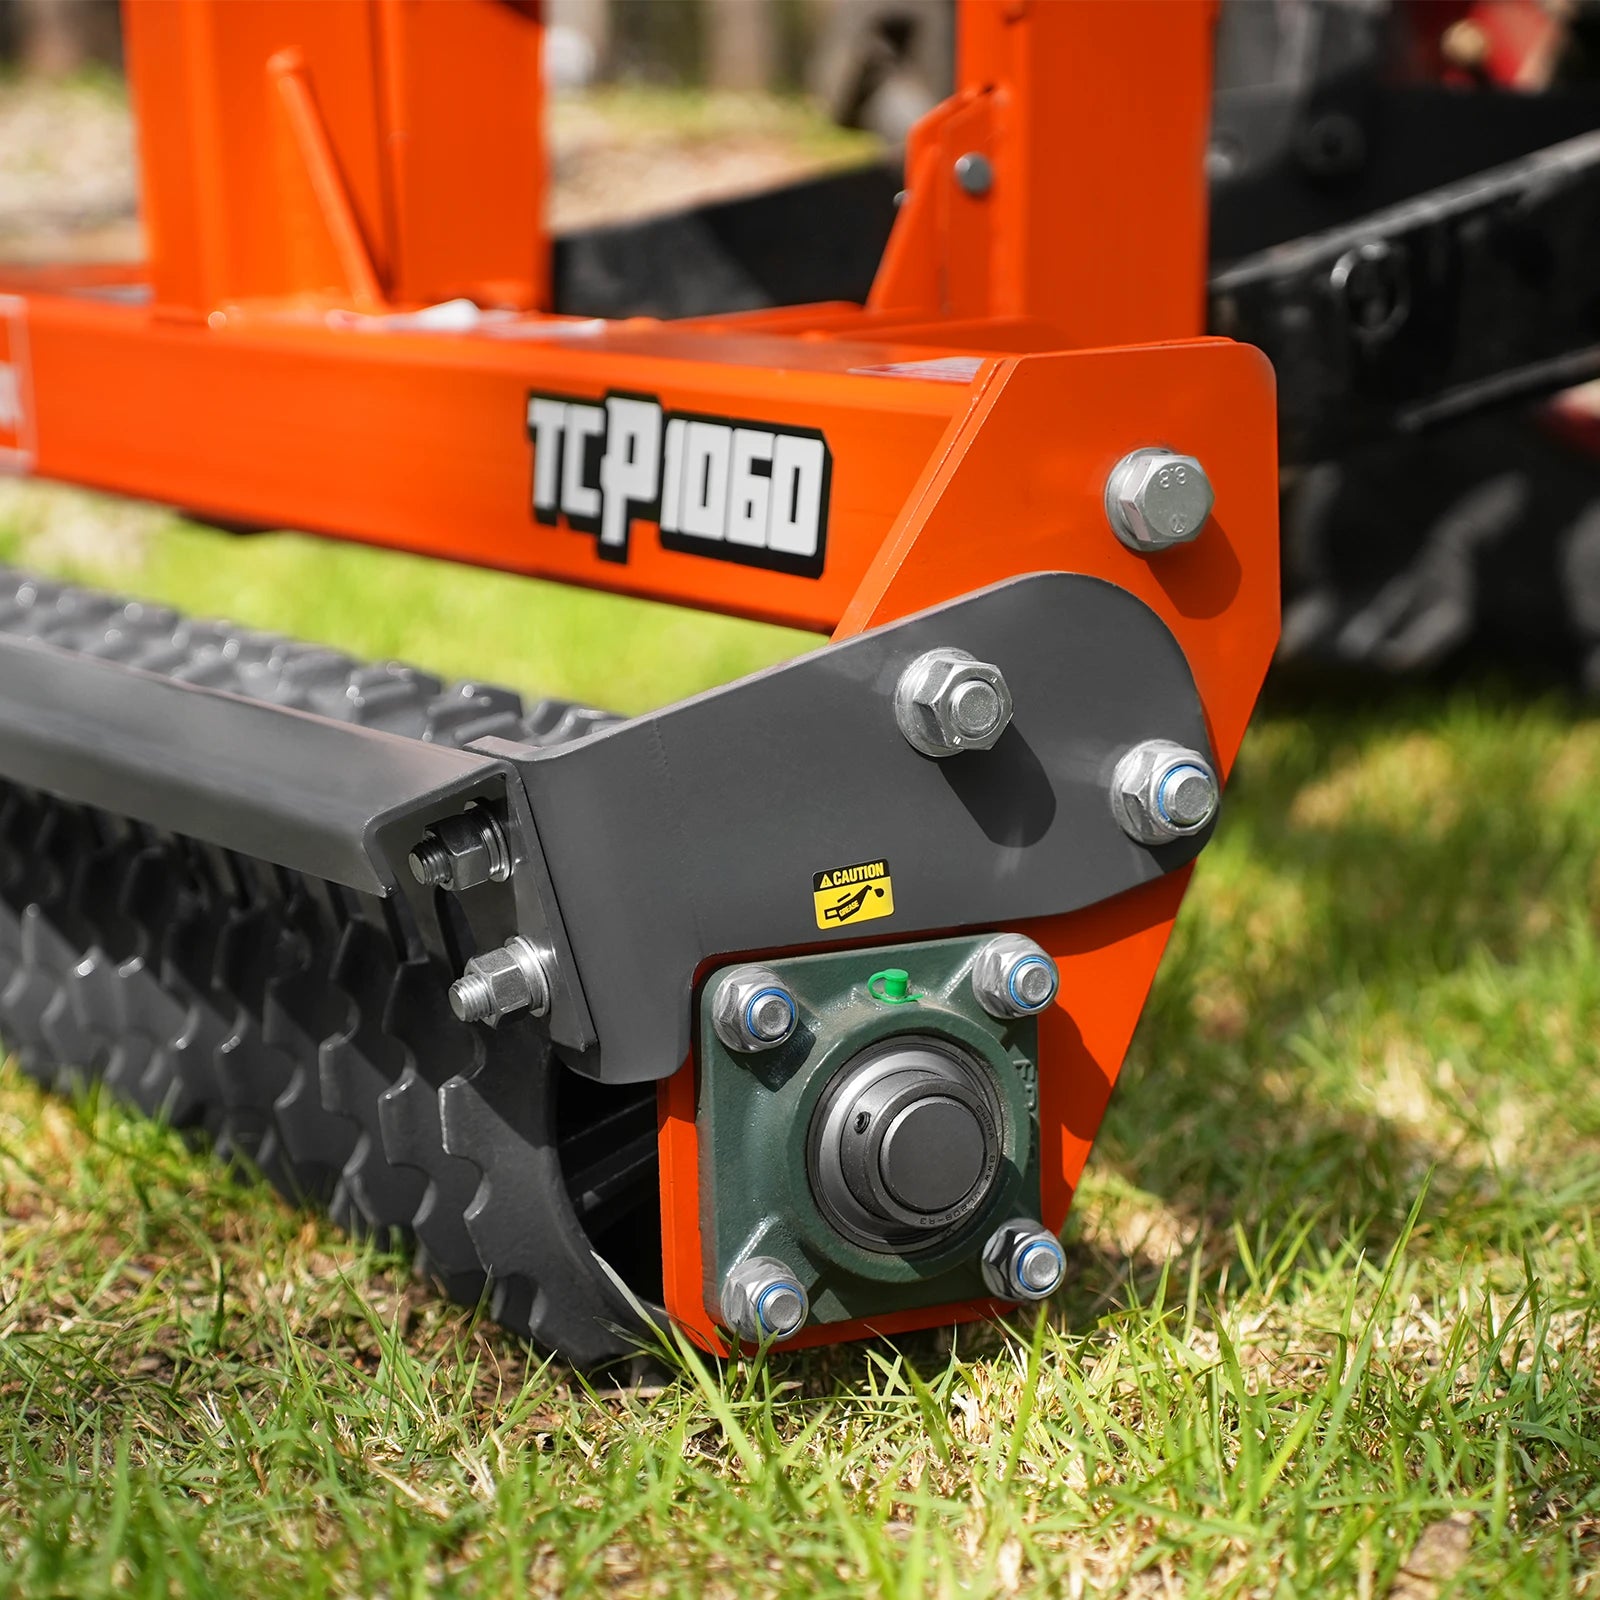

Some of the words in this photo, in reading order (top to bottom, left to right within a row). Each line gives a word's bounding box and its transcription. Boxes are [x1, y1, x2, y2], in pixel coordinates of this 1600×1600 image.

[527, 396, 826, 558] TCP1060
[832, 862, 885, 886] CAUTION
[975, 1104, 995, 1140] CHINA
